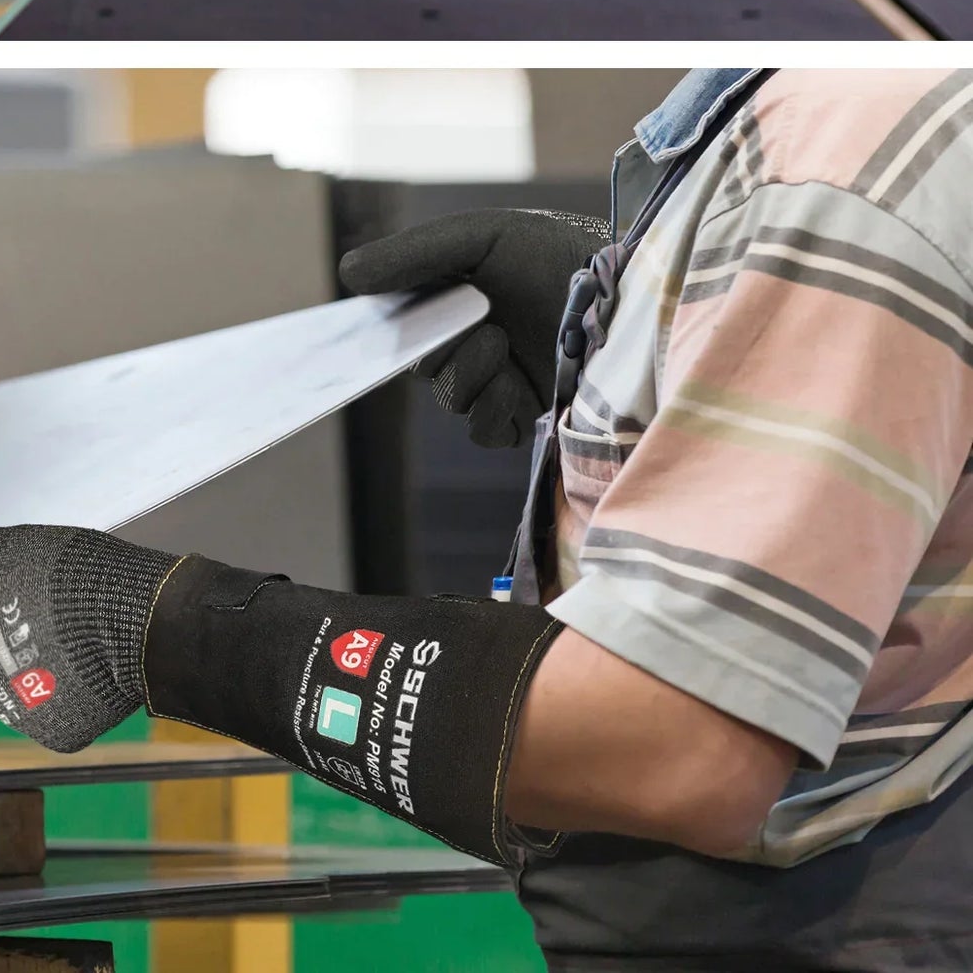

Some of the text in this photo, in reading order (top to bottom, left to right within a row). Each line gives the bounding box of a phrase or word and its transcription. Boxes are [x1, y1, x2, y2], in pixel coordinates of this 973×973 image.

[314, 637, 322, 645] &
[317, 618, 331, 635] Cut
[341, 632, 369, 669] A9
[22, 672, 51, 698] A9
[300, 647, 318, 695] Puncture
[322, 699, 356, 728] L
[366, 642, 405, 794] Model No: PM915
[390, 669, 426, 815] SCHWER
